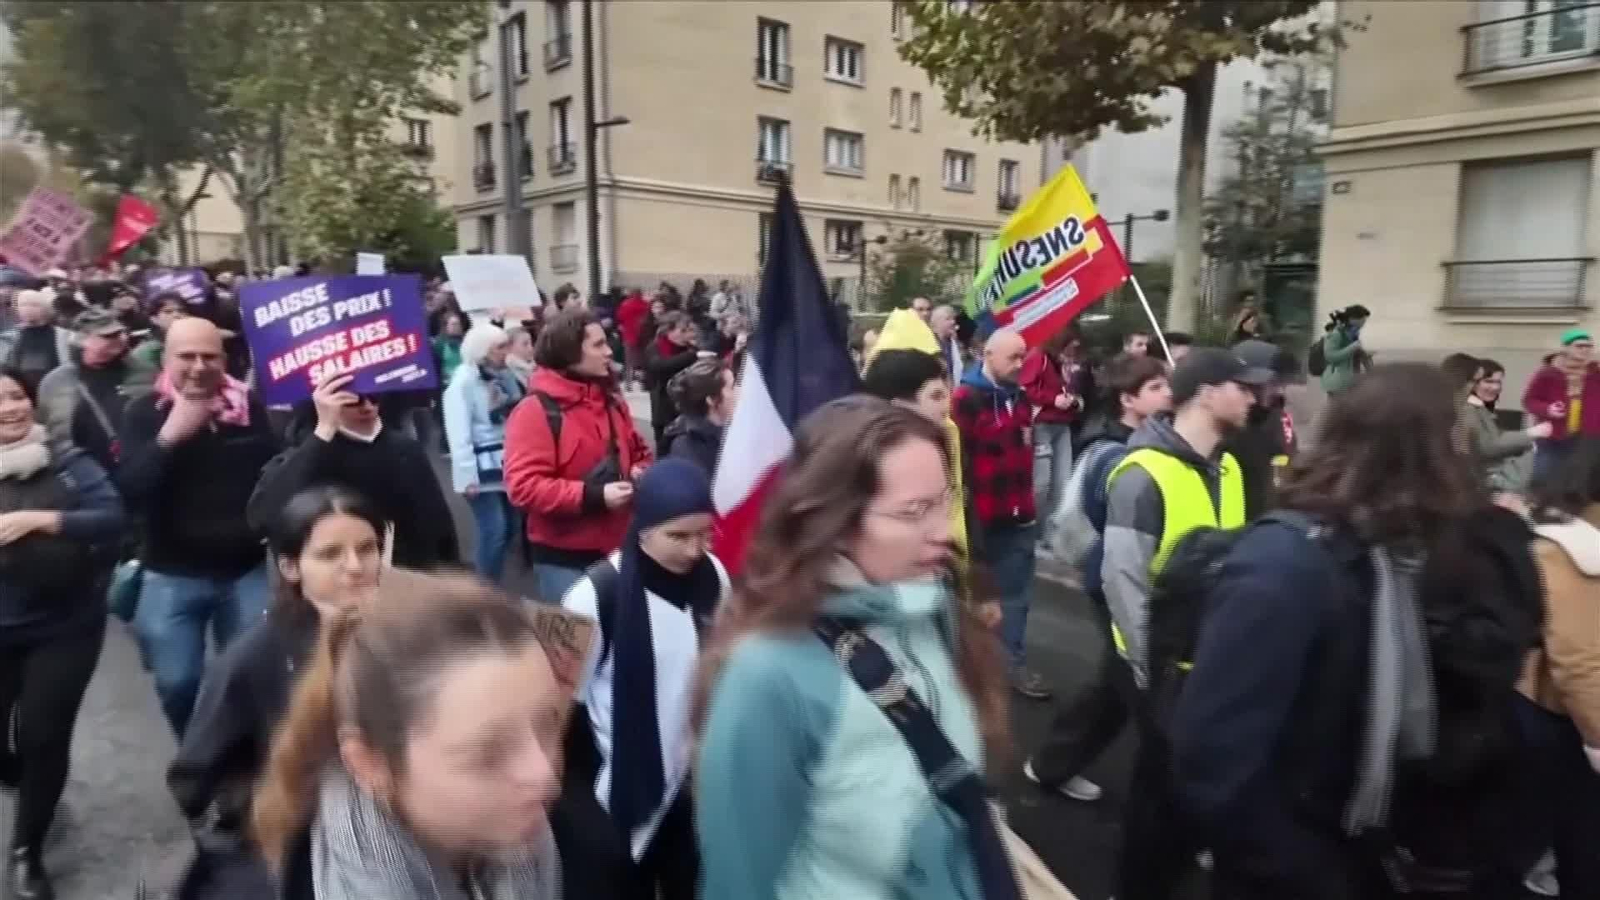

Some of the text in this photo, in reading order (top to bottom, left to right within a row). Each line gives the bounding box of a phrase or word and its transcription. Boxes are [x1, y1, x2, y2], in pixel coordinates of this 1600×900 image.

[254, 282, 329, 328] BAISSE
[289, 307, 332, 337] DES
[268, 331, 348, 381] HAUSSE
[350, 319, 390, 348] DES
[307, 340, 406, 386] SALAIRES
